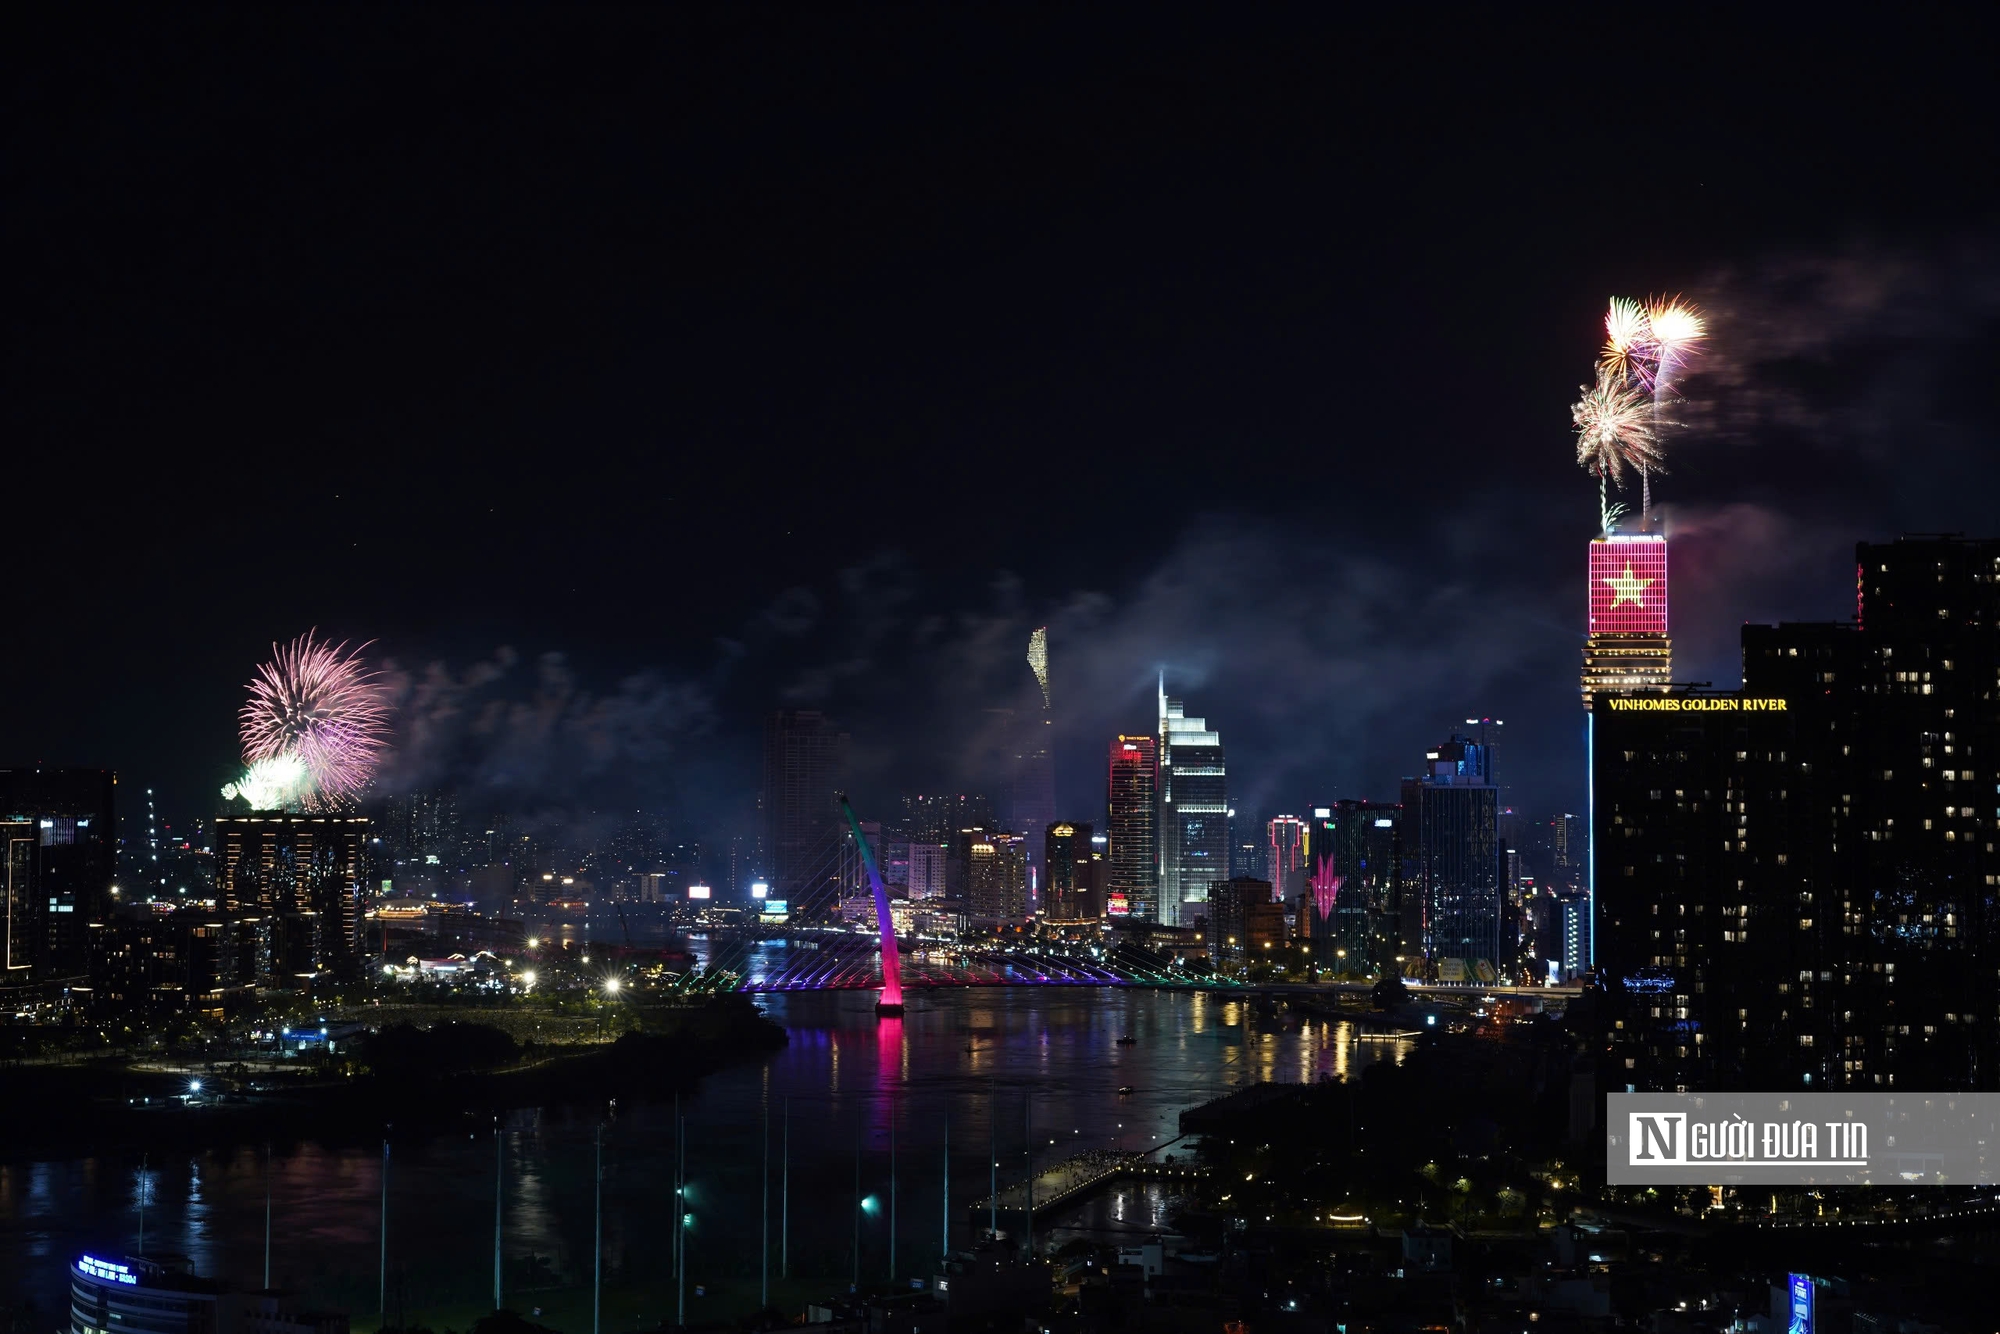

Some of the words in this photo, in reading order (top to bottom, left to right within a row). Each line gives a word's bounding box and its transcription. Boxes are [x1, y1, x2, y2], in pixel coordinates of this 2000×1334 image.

[1609, 699, 1680, 711] VINHOMES
[1682, 699, 1739, 711] GOLDEN
[1743, 699, 1787, 711] RIVER
